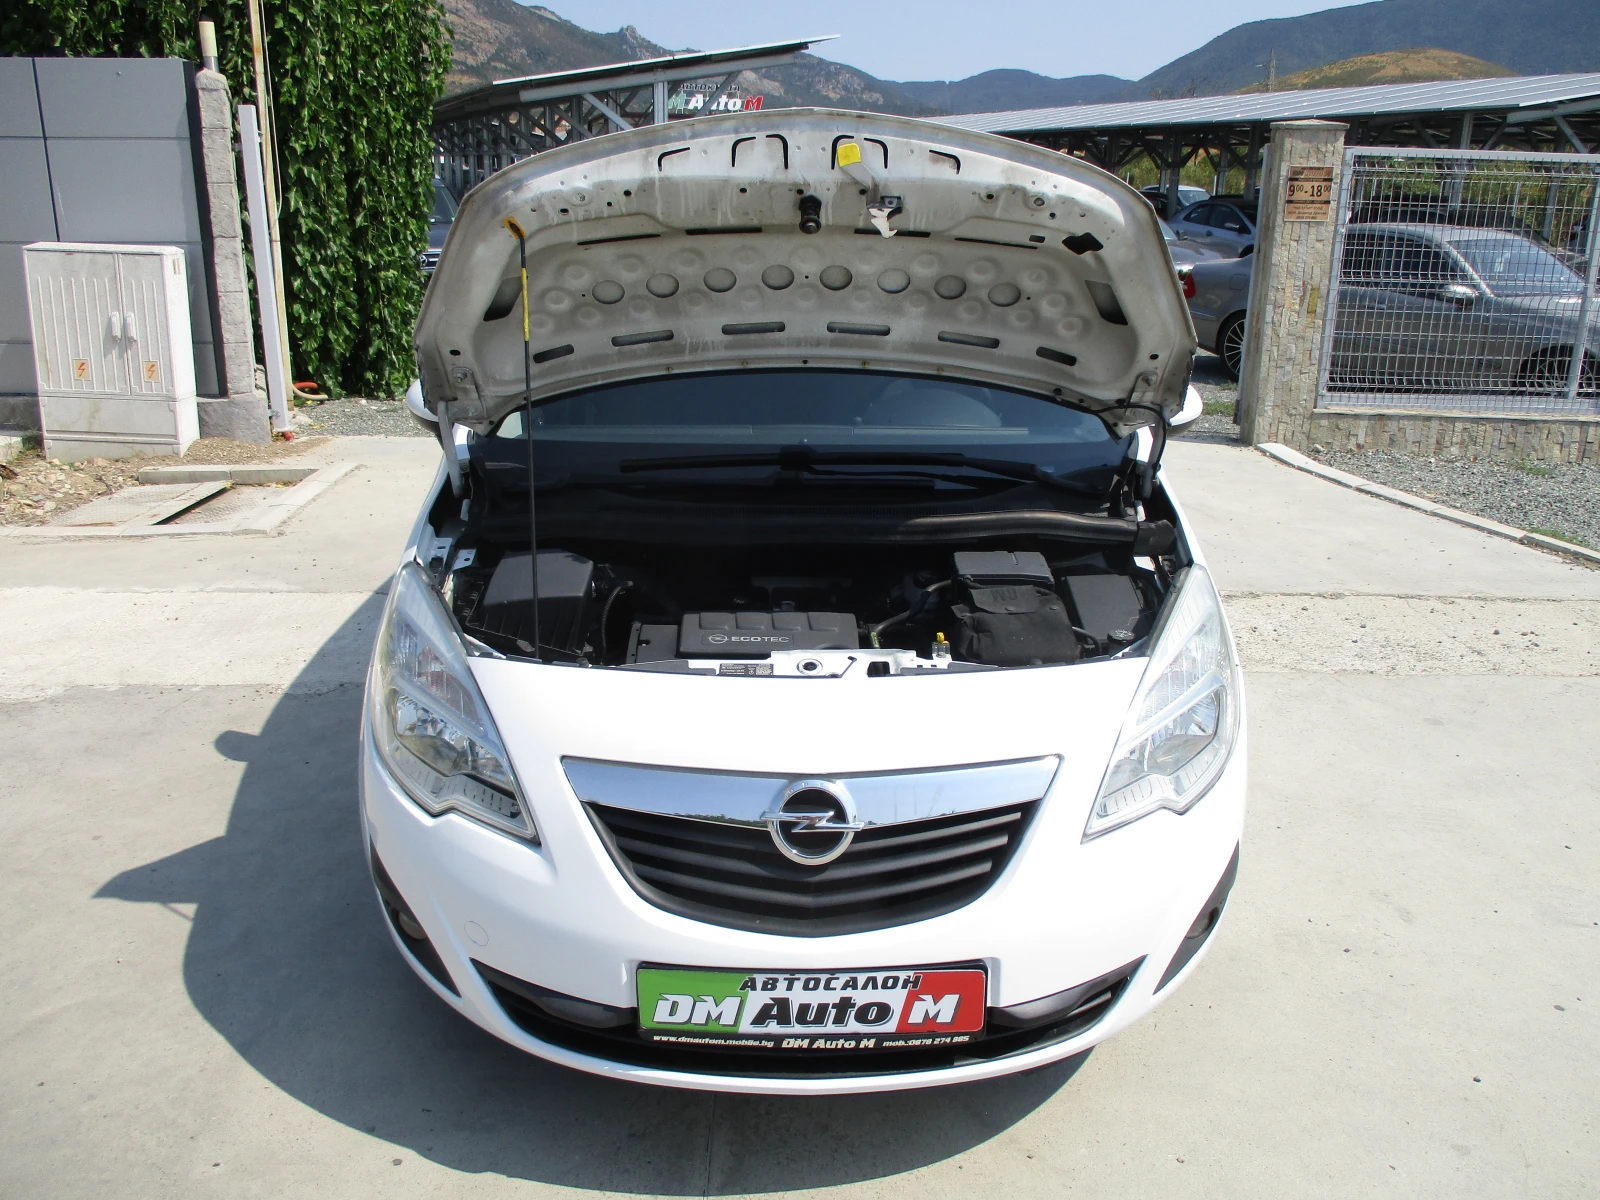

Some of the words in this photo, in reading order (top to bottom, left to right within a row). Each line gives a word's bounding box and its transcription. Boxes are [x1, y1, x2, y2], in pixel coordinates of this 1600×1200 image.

[744, 95, 763, 111] M
[738, 975, 922, 992] АВТОСАЛОН
[651, 993, 743, 1026] DM
[749, 996, 894, 1028] Auto
[907, 993, 961, 1025] M
[781, 1037, 810, 1048] DM
[812, 1038, 856, 1048] Auto
[859, 1037, 876, 1048] M
[933, 1036, 951, 1045] 274
